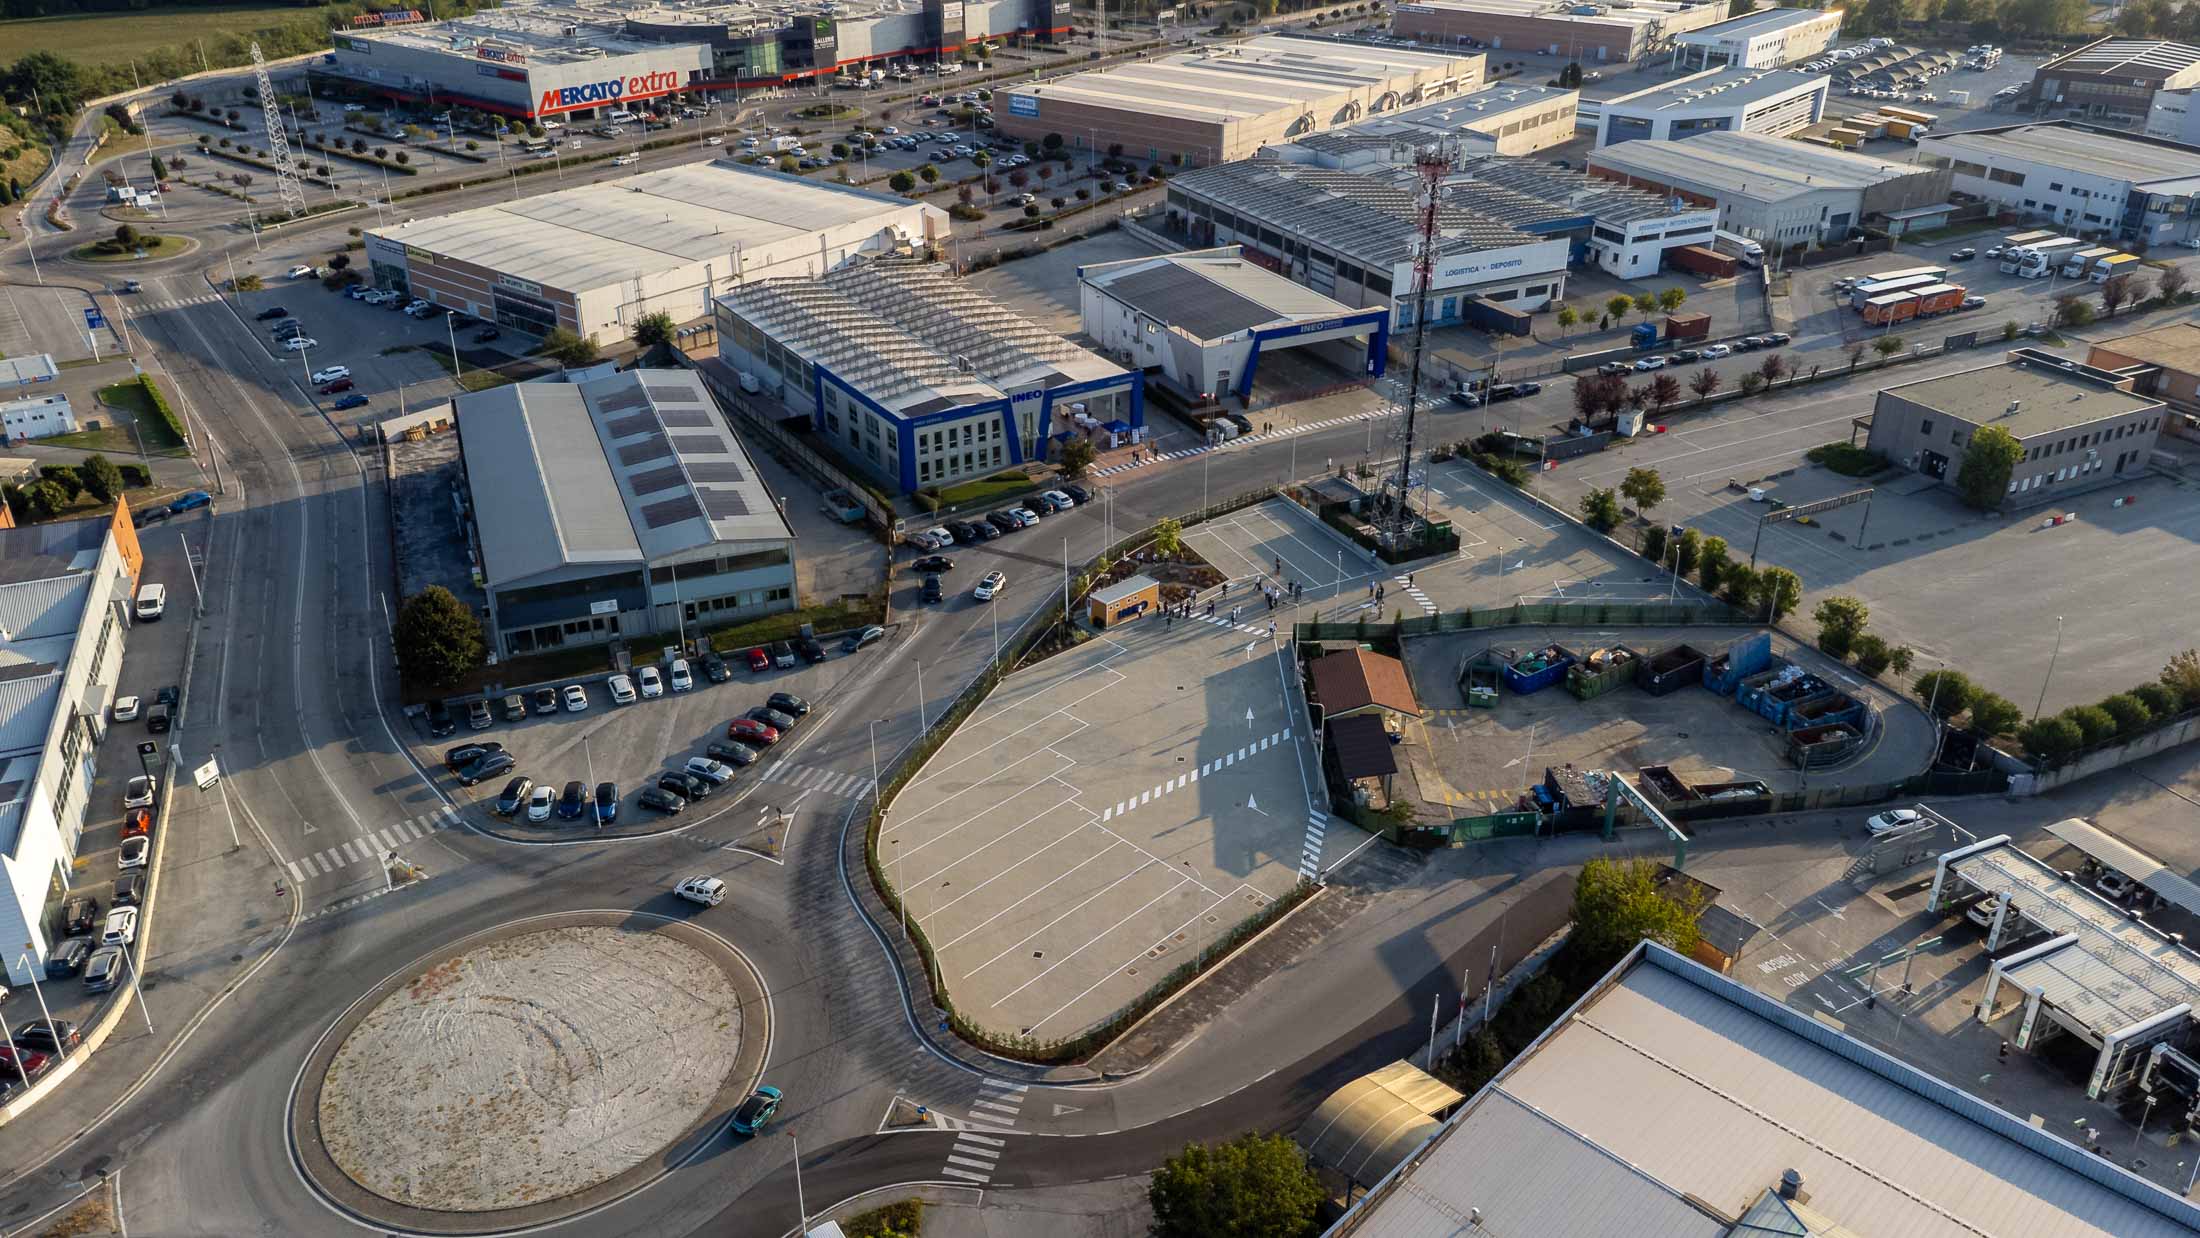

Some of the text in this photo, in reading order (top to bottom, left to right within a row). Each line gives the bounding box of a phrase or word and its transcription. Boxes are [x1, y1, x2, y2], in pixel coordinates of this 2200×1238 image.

[628, 71, 678, 95] extra
[1445, 258, 1522, 277] LOGISTICA DEPOSITO
[1300, 323, 1324, 333] INEO
[1012, 389, 1043, 403] INEO
[1783, 970, 1810, 987] AUTO
